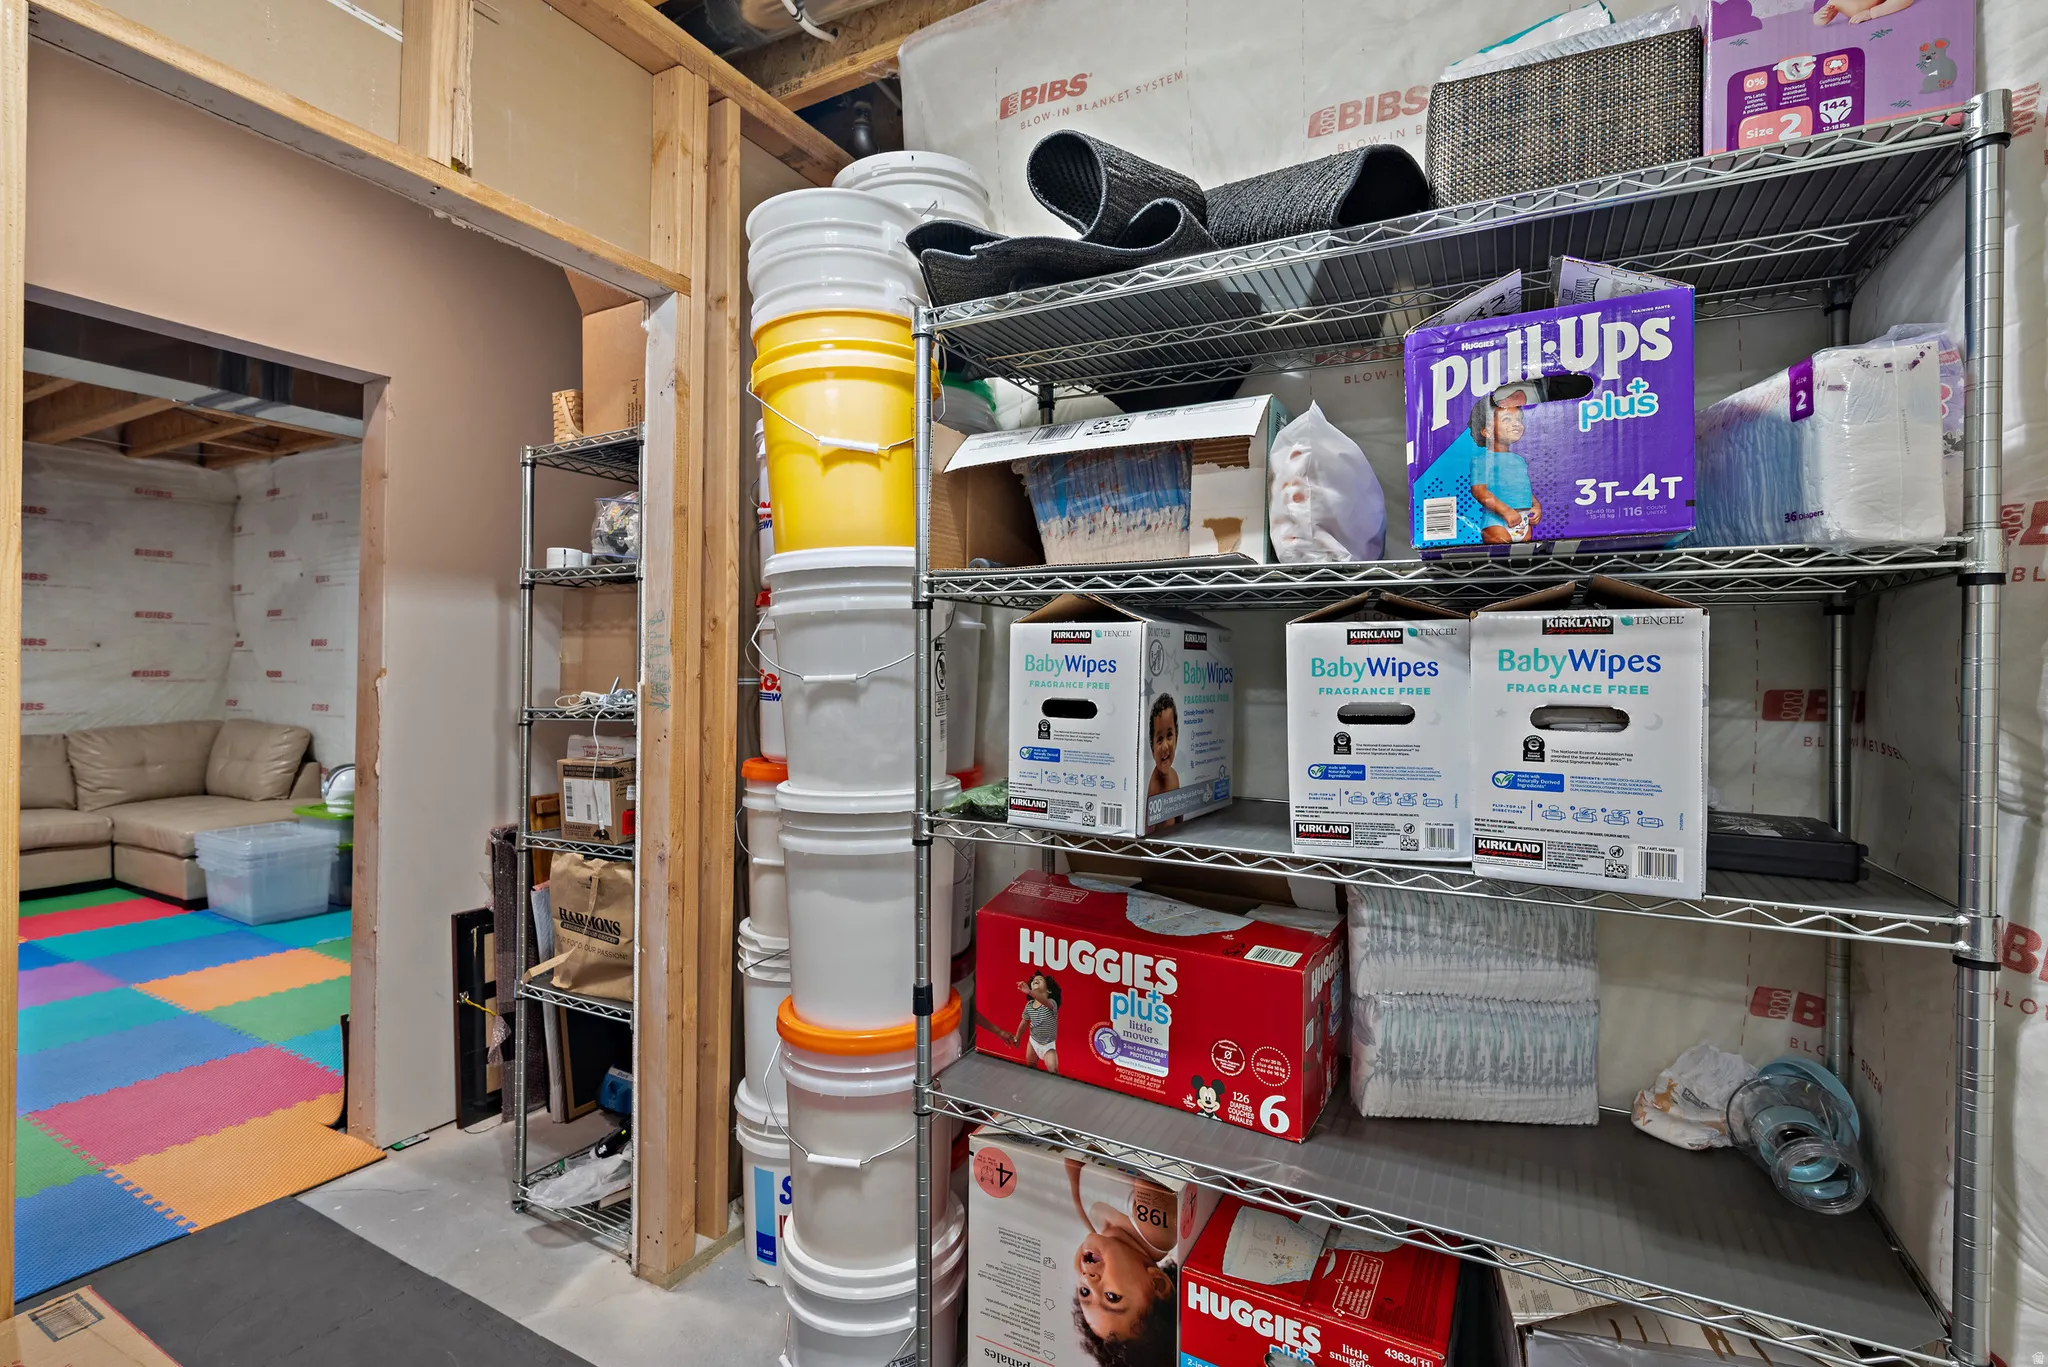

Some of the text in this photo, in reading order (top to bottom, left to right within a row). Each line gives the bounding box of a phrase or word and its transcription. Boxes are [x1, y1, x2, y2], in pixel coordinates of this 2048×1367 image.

[1746, 77, 1765, 89] 0%
[1020, 72, 1088, 112] BIBS
[1020, 70, 1184, 130] BLOW-IN BLANKET SYSTEM
[1823, 99, 1848, 112] 144
[1338, 86, 1428, 132] BIBS
[1746, 113, 1802, 141] Size 2
[1461, 340, 1495, 351] HUGGIES
[1795, 390, 1807, 412] 2
[1574, 473, 1683, 506] 3T-4T
[1623, 506, 1643, 517] 116
[1784, 509, 1824, 523] 36 Diapers
[1546, 618, 1611, 628] KIRKLAND
[1635, 616, 1683, 625] TENCEL
[1053, 631, 1091, 640] KIRKLAND
[1350, 630, 1401, 640] KIRKLAND
[1419, 628, 1456, 637] TENCEL
[1029, 680, 1110, 690] FRAGRANCE FREE
[1319, 687, 1431, 696] FRAGRANCE FREE
[1506, 683, 1649, 695] FRAGRANCE FREE
[1010, 797, 1047, 809] KIRKLAND
[1298, 824, 1349, 834] KIRKLAND
[1478, 840, 1541, 853] KIRKLAND
[1019, 928, 1178, 995] HUGGIES
[1311, 940, 1344, 1003] HUGGIES
[1112, 990, 1170, 1025] plus
[1129, 1020, 1153, 1034] little
[1123, 1030, 1159, 1045] movers
[1129, 1051, 1161, 1063] PROTECTION
[1137, 1046, 1154, 1056] ACTIVE
[1154, 1051, 1167, 1059] BABY
[1115, 1067, 1146, 1079] PROTECTION
[1146, 1081, 1161, 1089] ACTIF
[1233, 1091, 1250, 1104] 126
[1228, 1107, 1254, 1120] COUCHES
[1229, 1101, 1252, 1113] DIAPERS
[1260, 1095, 1290, 1134] 6
[996, 1163, 1014, 1188] 4
[1137, 1204, 1169, 1228] 198
[1187, 1281, 1322, 1354] HUGGIES
[1342, 1343, 1369, 1361] little
[1384, 1347, 1417, 1367] 43634
